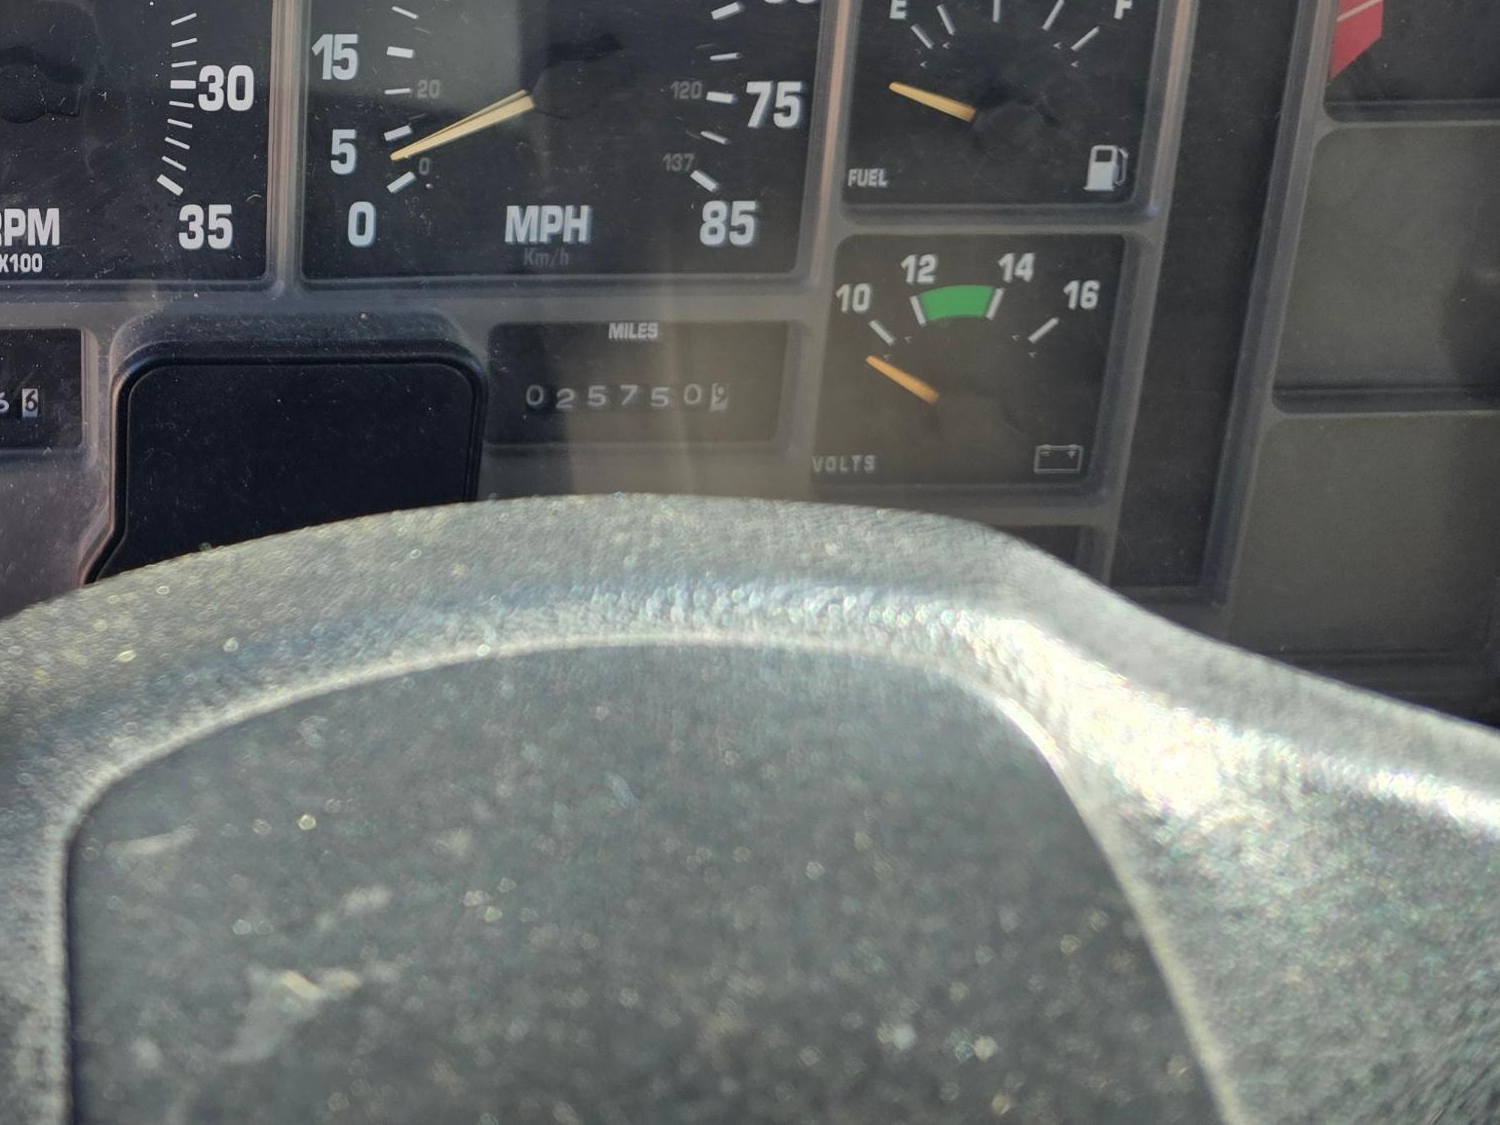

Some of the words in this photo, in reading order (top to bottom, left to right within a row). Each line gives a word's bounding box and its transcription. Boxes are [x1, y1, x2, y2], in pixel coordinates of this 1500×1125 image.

[311, 33, 358, 81] 15
[198, 64, 254, 111] 30
[417, 79, 441, 99] 20
[670, 80, 702, 100] 120
[745, 81, 803, 129] 75
[330, 129, 357, 174] 5
[663, 152, 695, 171] 137
[848, 168, 889, 188] FUEL
[178, 204, 233, 250] 35
[348, 201, 376, 248] 0
[505, 205, 591, 244] MPH
[699, 200, 757, 245] 85
[901, 254, 938, 284] 12
[998, 252, 1035, 283] 14
[836, 283, 872, 313] 10
[1063, 280, 1100, 310] 16
[608, 323, 659, 340] MILES
[812, 455, 876, 473] VOLTS
